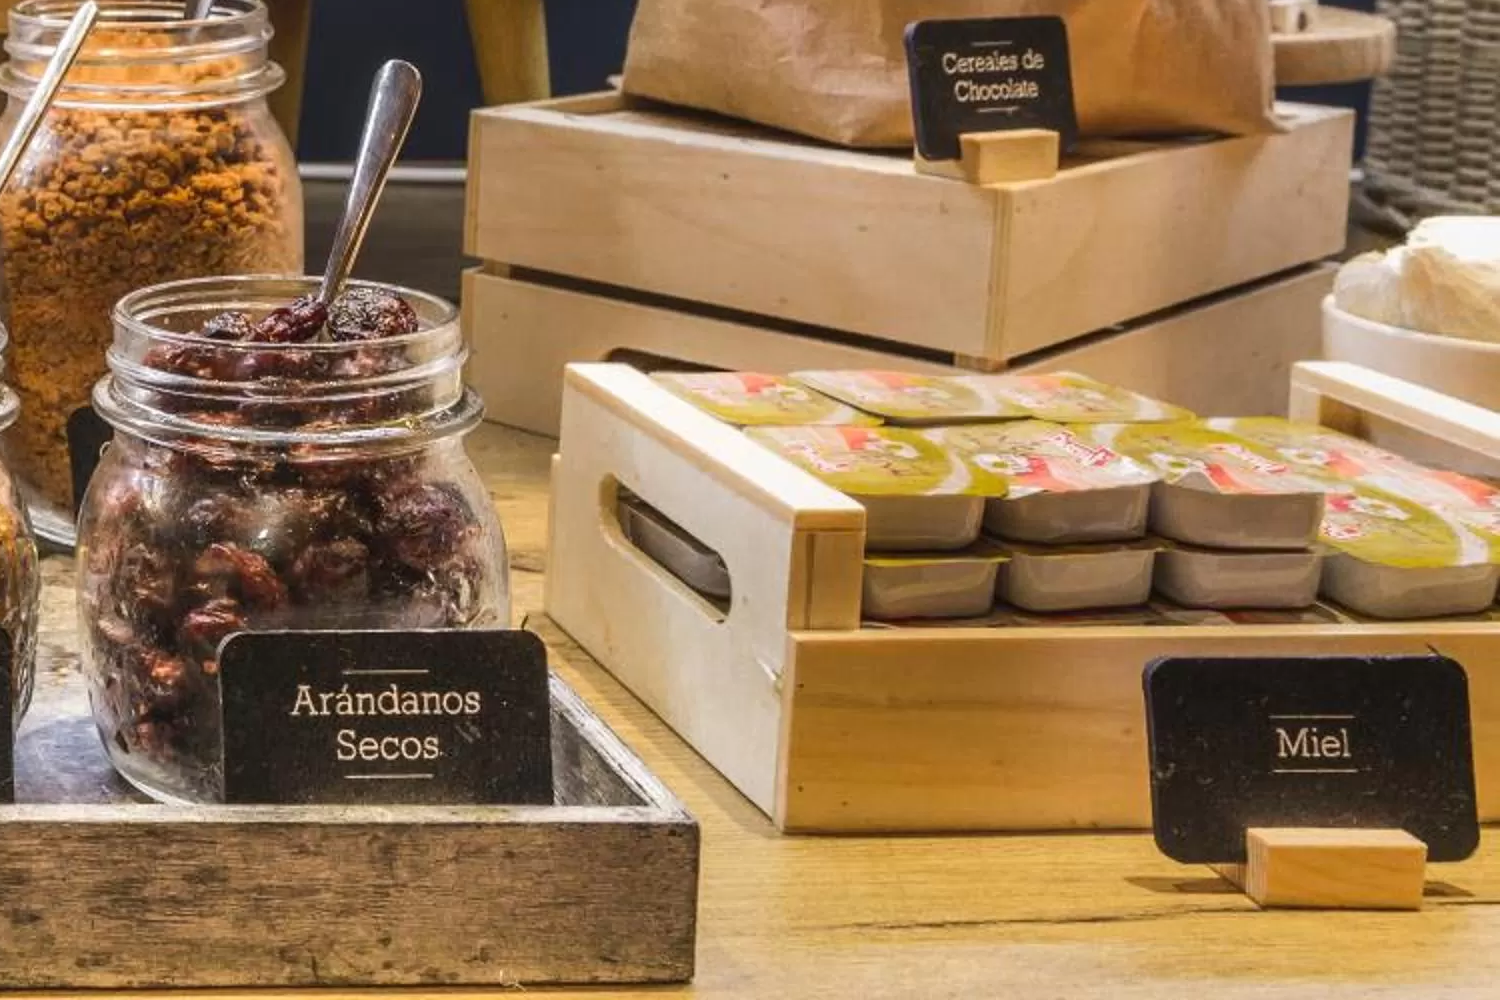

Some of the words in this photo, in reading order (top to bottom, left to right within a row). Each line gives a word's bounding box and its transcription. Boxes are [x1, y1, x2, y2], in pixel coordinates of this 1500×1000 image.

[942, 49, 1019, 74] Cereales
[1021, 47, 1045, 70] de
[954, 77, 1040, 103] Chocolate
[289, 682, 481, 716] Arándanos
[337, 729, 440, 761] Secos
[1275, 726, 1352, 758] Miel
